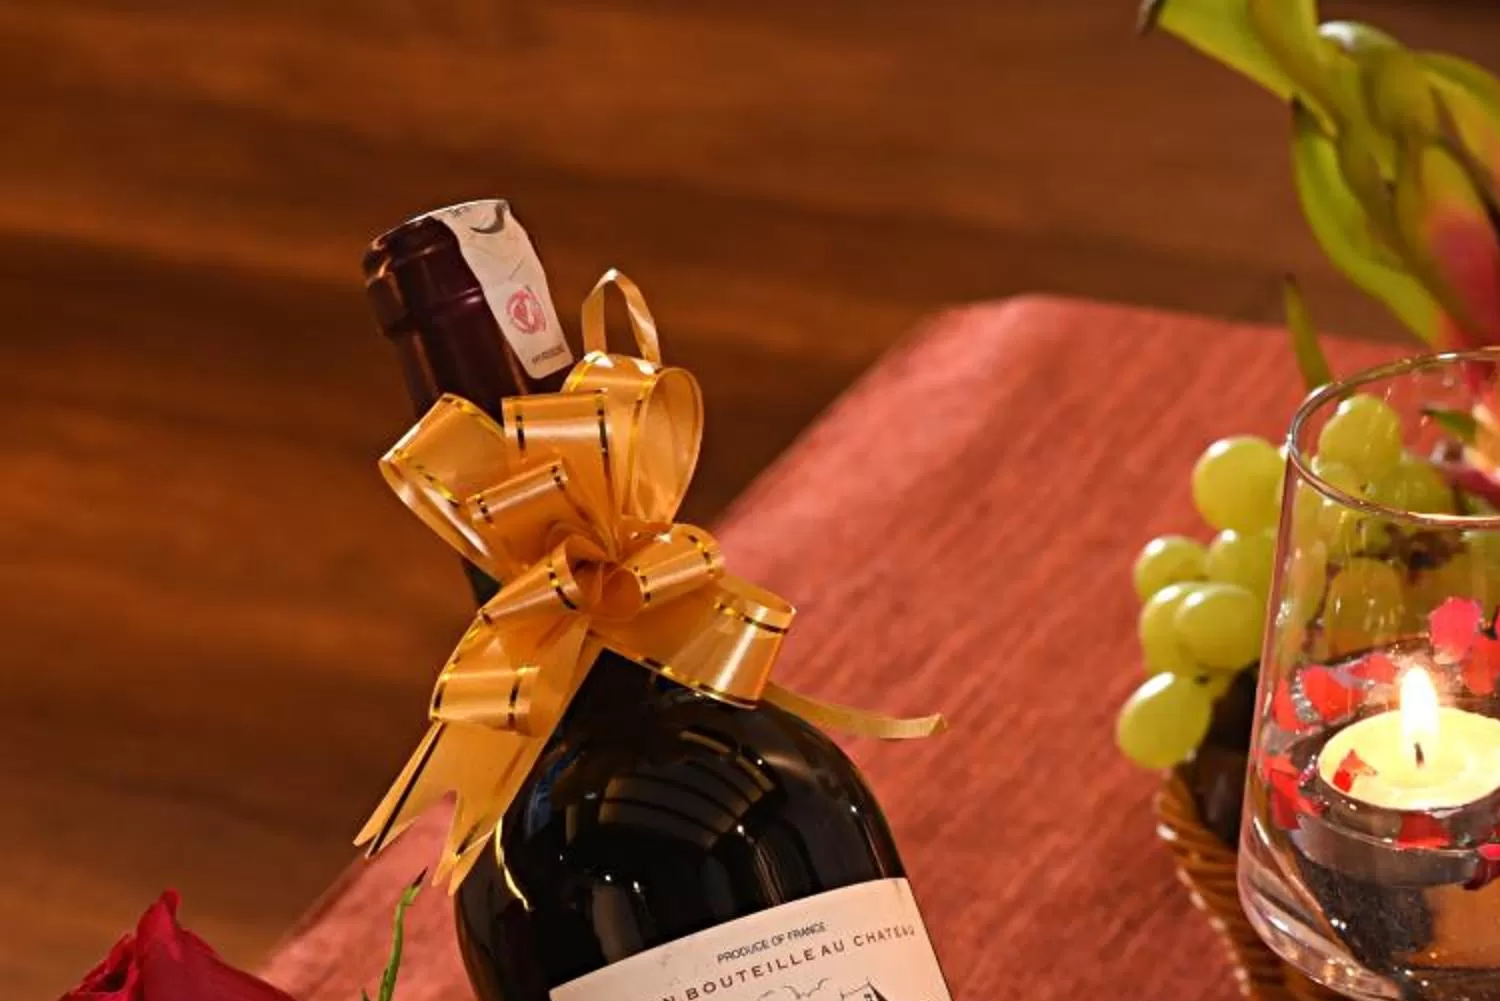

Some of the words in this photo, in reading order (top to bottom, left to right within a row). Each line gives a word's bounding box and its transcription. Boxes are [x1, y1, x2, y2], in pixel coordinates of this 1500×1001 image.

[717, 939, 770, 965] PRODUCE
[771, 932, 786, 947] OF
[786, 921, 826, 942] FRANCE
[685, 949, 816, 1001] BOUTEILLE
[820, 939, 846, 958] AU
